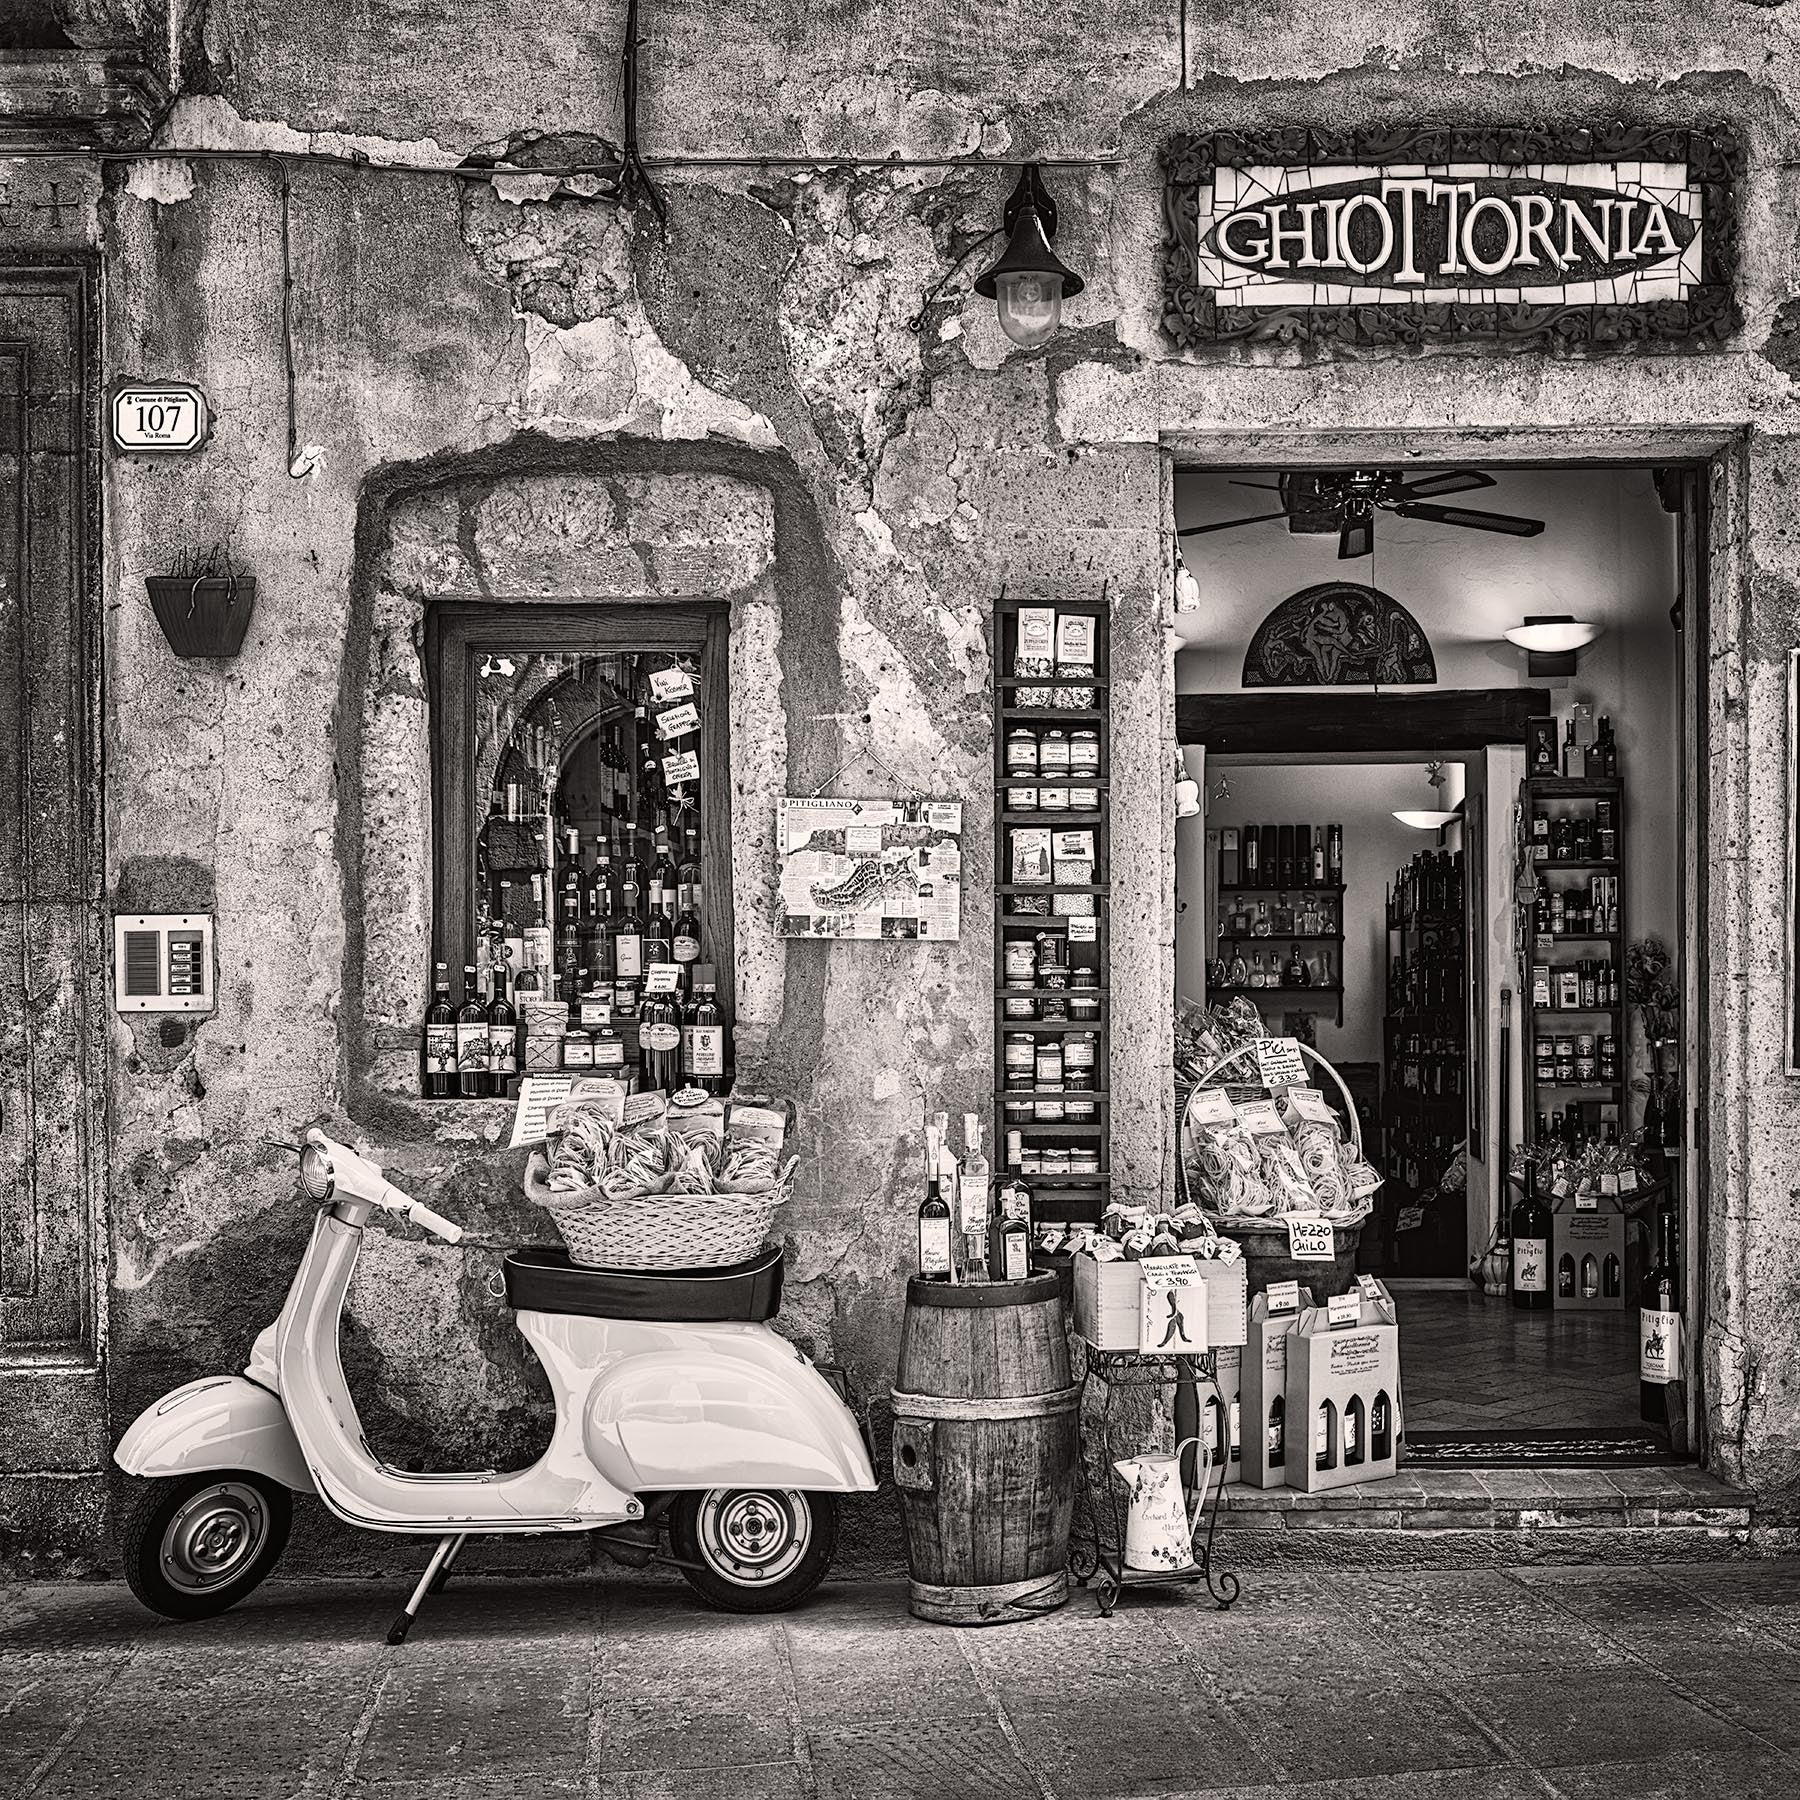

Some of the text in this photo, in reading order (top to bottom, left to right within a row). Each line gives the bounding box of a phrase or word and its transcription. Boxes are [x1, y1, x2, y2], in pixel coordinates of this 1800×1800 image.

[1217, 178, 1682, 284] GHIOTTORNIA
[136, 404, 181, 432] 107
[789, 800, 852, 808] PITIGLIANO
[1259, 1040, 1286, 1055] Pici
[1292, 1221, 1331, 1237] MEZZO
